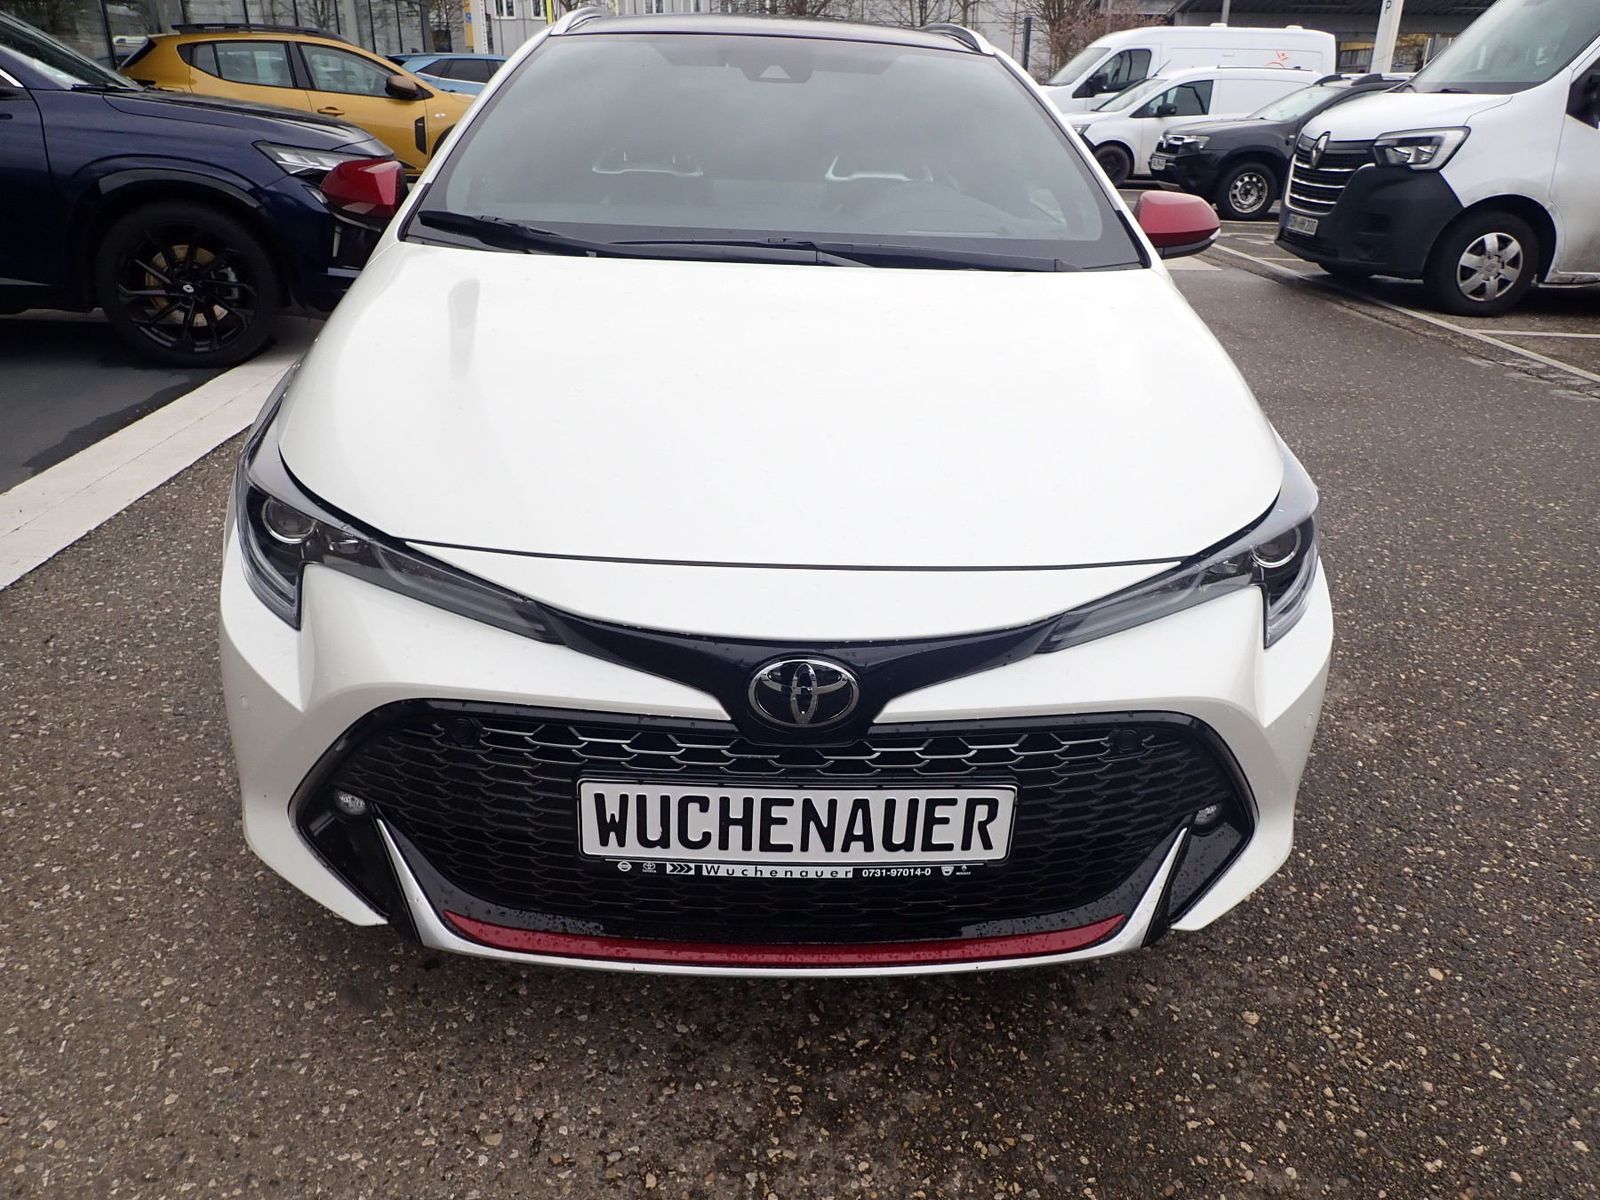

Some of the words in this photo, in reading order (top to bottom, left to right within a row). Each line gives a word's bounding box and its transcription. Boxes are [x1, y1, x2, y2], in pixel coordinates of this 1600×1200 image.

[593, 792, 1000, 853] WUCHENAUER
[705, 865, 852, 878] Wuchenauer
[862, 867, 932, 877] 0731-97014-0
